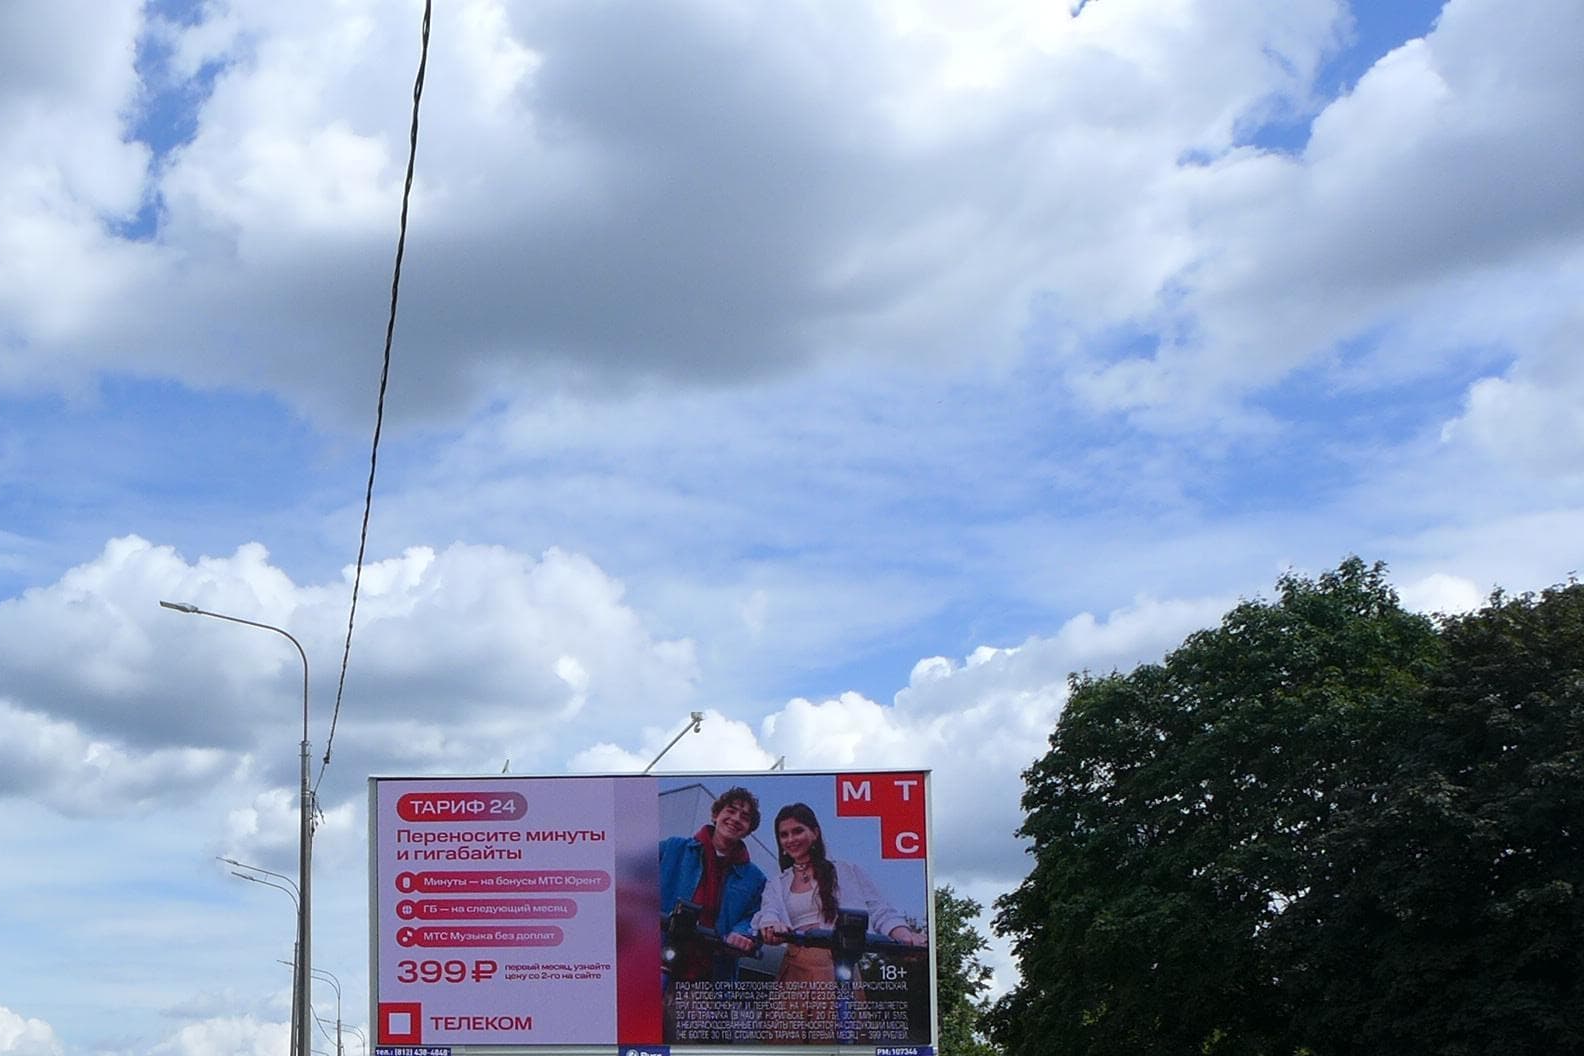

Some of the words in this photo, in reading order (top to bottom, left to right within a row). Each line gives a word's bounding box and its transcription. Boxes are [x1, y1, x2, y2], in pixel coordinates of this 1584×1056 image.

[842, 780, 871, 801] М
[894, 780, 917, 801] Т
[410, 799, 485, 814] ТАРИФ
[490, 799, 516, 814] 24
[397, 829, 521, 846] Переносите
[526, 829, 606, 845] минуты
[895, 831, 919, 854] С
[397, 850, 409, 860] и
[415, 846, 522, 860] гигабайты
[423, 877, 467, 888] Минуты
[480, 878, 495, 886] на
[495, 876, 537, 888] бонусы
[538, 876, 563, 885] МТС
[565, 876, 602, 887] Юрент
[423, 904, 438, 913] ГБ
[467, 903, 531, 915] следующий
[533, 905, 568, 914] месяц
[423, 932, 448, 941] МТС
[450, 931, 494, 942] Музыка
[495, 931, 514, 940] без
[516, 932, 554, 941] доплат
[397, 960, 466, 983] 399
[505, 963, 540, 971] первый
[574, 963, 611, 972] узнайте
[880, 965, 907, 980] 18+
[541, 972, 560, 980] 2-го
[430, 1016, 532, 1031] ТЕЛЕКОМ
